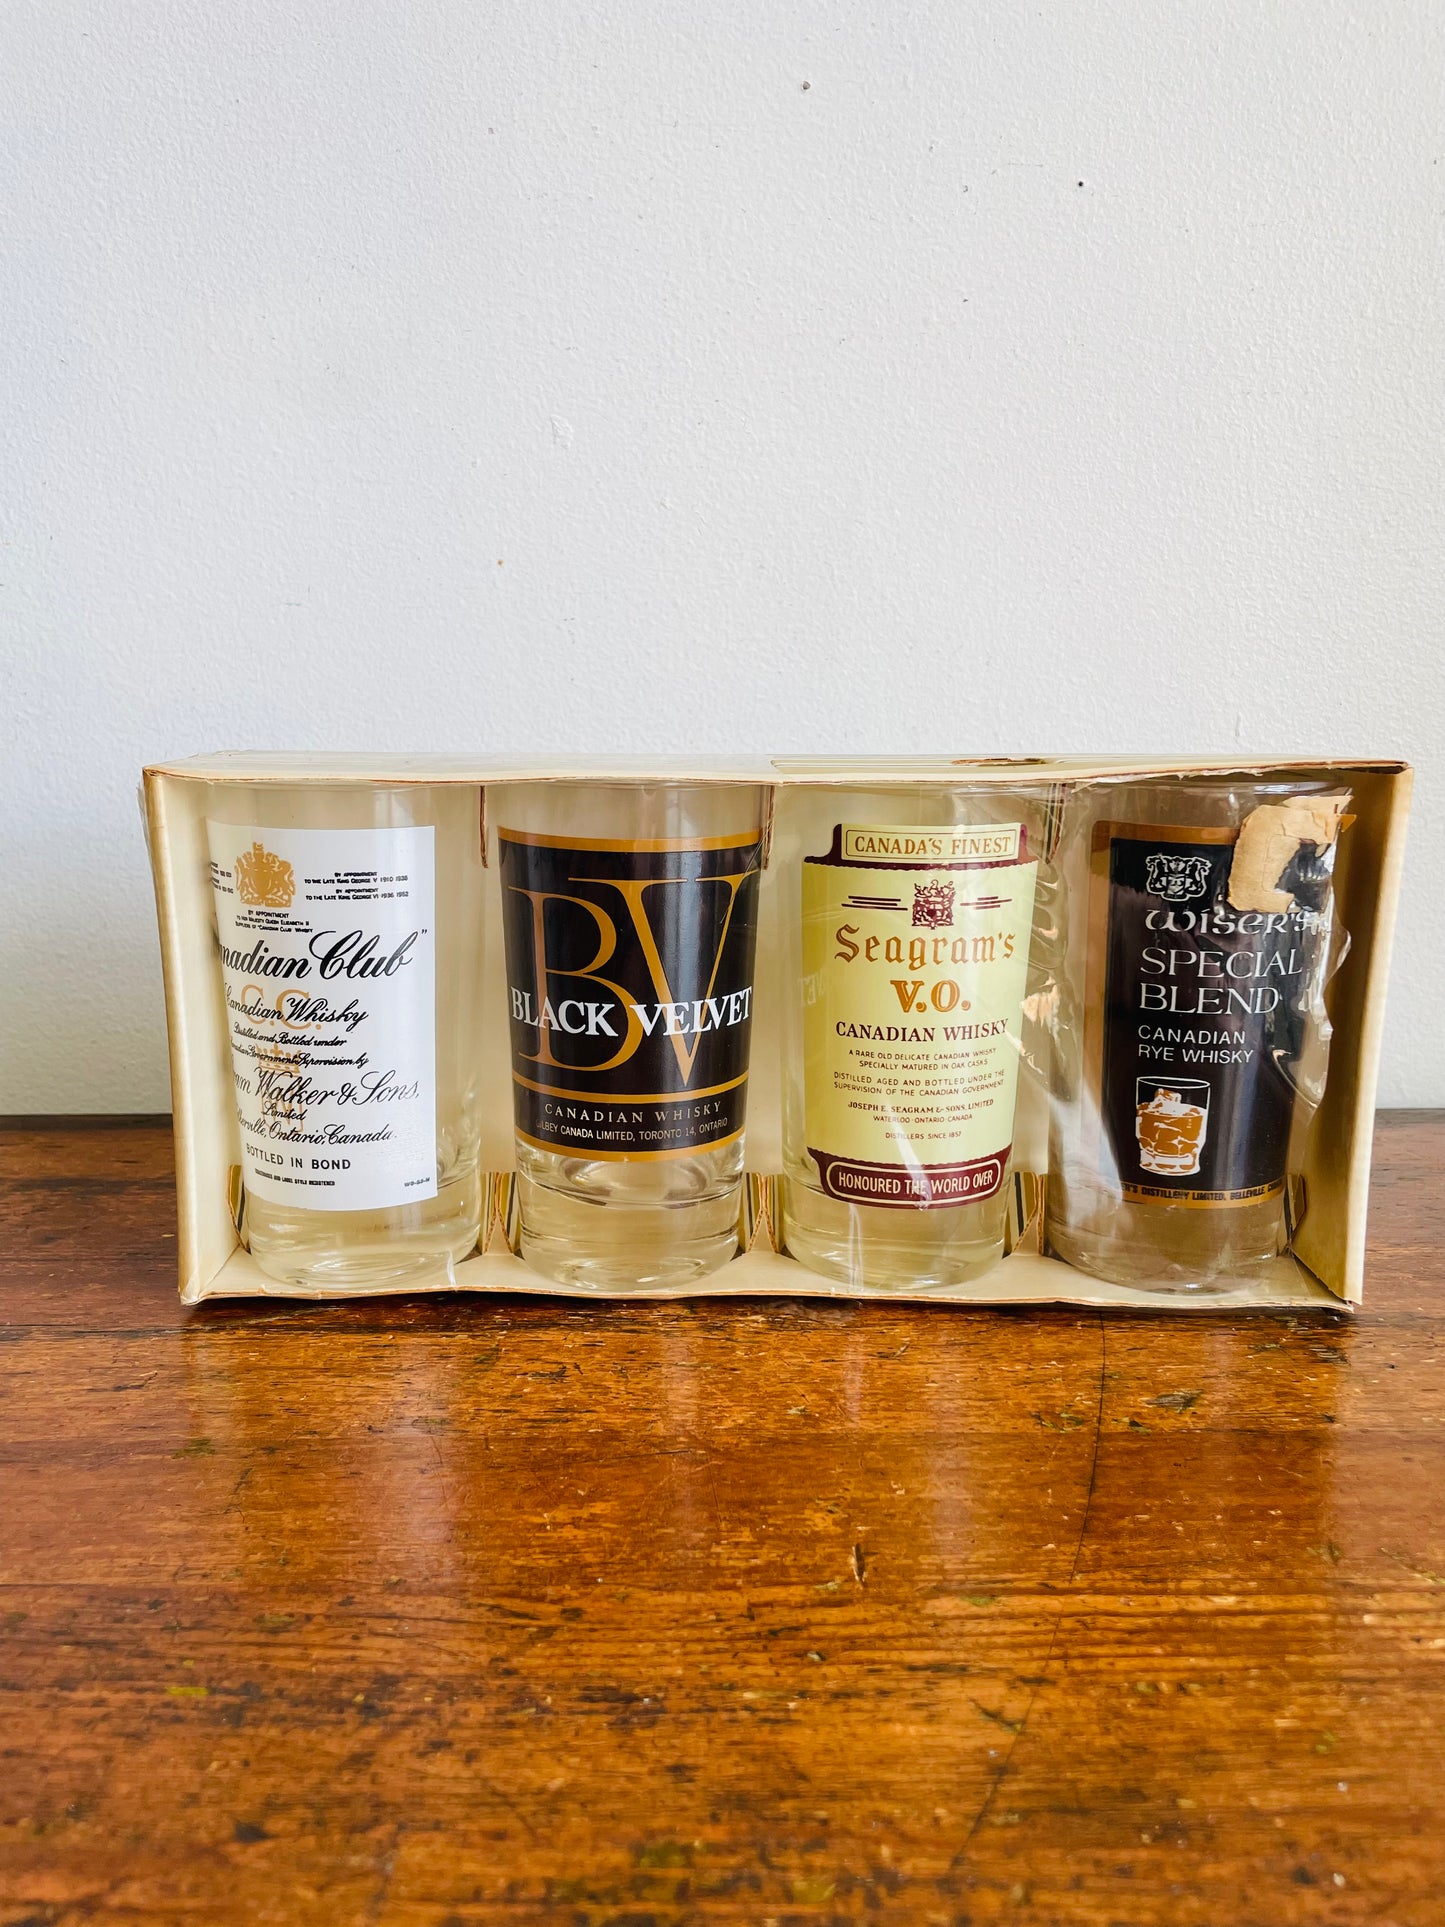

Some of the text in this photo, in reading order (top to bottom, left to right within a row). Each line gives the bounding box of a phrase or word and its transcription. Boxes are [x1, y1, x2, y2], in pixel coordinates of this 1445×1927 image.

[855, 835, 1011, 855] CANADA'S FINEST
[255, 910, 289, 919] APPOINTMENT
[834, 923, 1016, 971] Seagram's
[219, 940, 312, 979] nadian
[1140, 946, 1302, 979] SPECIAL
[890, 979, 971, 1013] V.O.
[1139, 982, 1282, 1015] BLEND
[286, 997, 369, 1033] Whisky
[511, 986, 618, 1037] BLACK
[630, 986, 752, 1037] VELVET
[835, 1018, 1009, 1042] CANADIAN WHISKY
[1138, 1024, 1246, 1045] CANADIAN
[856, 1050, 875, 1059] RARE
[877, 1052, 892, 1060] OLD
[894, 1053, 930, 1061] DELICATE
[933, 1052, 970, 1060] CANADIAN
[973, 1047, 997, 1057] WHISKY
[859, 1060, 898, 1070] SPECIALLY
[967, 1059, 988, 1068] CASKS
[1138, 1044, 1254, 1064] RYE WHISKY
[253, 1066, 338, 1105] Walker
[337, 1082, 357, 1106] &
[834, 1068, 1005, 1087] DISTILLED AGED AND BOTTLED UNDER THE
[834, 1081, 882, 1094] SUPERVISION
[919, 1088, 959, 1096] CANADIAN
[962, 1079, 1005, 1094] GOVERNMENT
[261, 1100, 308, 1121] Limited
[544, 1101, 721, 1123] CANADIAN WHISKY
[848, 1101, 879, 1111] JOSEPH
[891, 1105, 934, 1114] SEAGRAM
[967, 1098, 994, 1110] LIMITED
[560, 1125, 593, 1139] CANADA
[596, 1130, 636, 1142] LIMITED,
[639, 1128, 682, 1141] TORONTO
[685, 1127, 697, 1137] 14,
[699, 1117, 728, 1133] ONTARIO
[885, 1132, 925, 1140] DISTILLERS
[246, 1143, 351, 1170] BOTTLED IN BOND
[838, 1169, 993, 1195] HONOURED THE WORLD OVER
